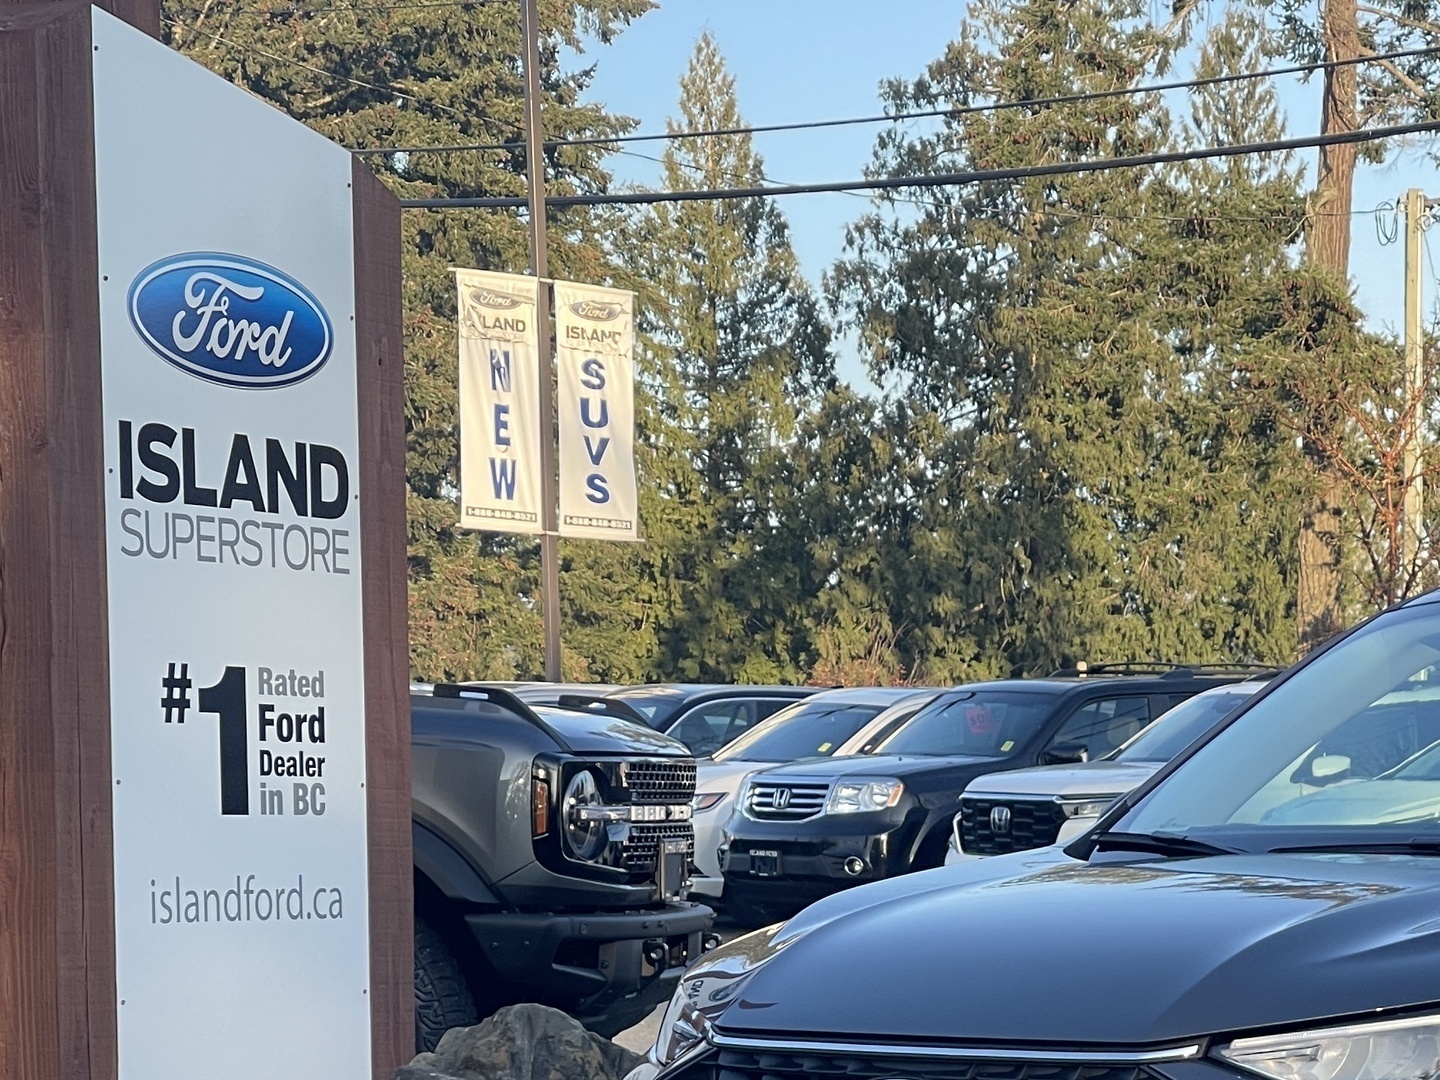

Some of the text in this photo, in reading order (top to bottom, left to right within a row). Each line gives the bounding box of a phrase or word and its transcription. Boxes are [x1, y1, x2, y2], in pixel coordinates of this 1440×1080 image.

[172, 271, 295, 368] Ford
[578, 301, 609, 319] Ford
[579, 358, 610, 504] SUVS
[118, 419, 349, 520] ISLAND
[120, 507, 350, 575] SUPERSTORE
[257, 666, 325, 698] Rated
[257, 703, 326, 744] Ford
[258, 749, 326, 777] Dealer
[259, 782, 326, 816] in BC
[150, 874, 343, 924] islandford.ca
